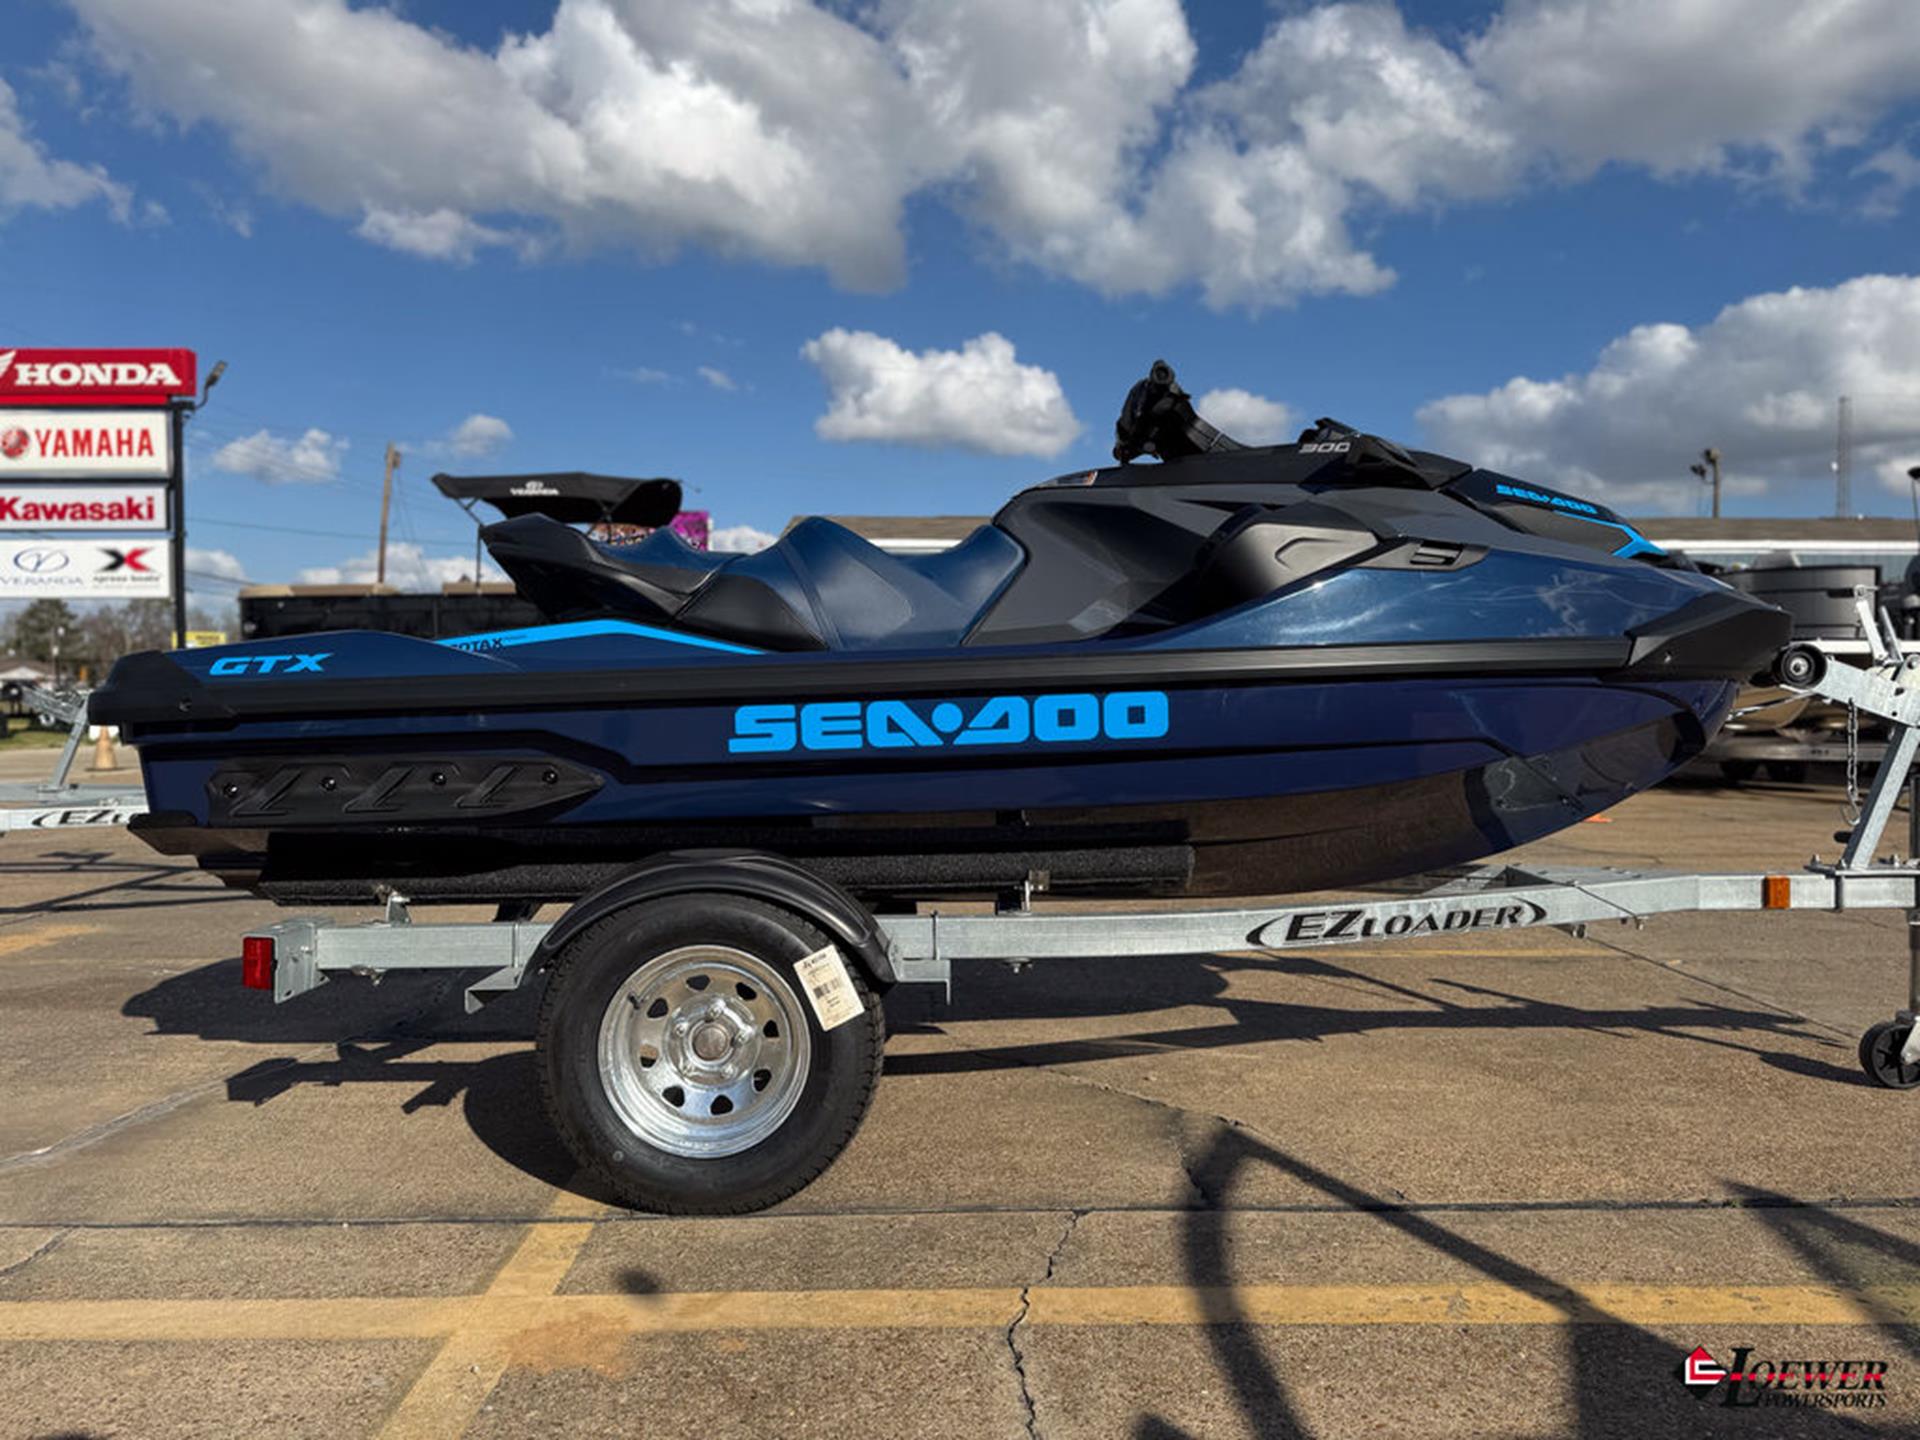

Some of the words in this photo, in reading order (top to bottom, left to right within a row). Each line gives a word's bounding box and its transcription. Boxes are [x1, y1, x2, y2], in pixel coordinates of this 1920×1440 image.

[14, 363, 182, 386] HONDA
[35, 429, 154, 458] YAMAHA
[1299, 441, 1351, 454] 300
[0, 496, 155, 521] Kawasaki
[0, 576, 83, 586] VERANDA
[452, 638, 505, 653] OTAX
[209, 652, 335, 676] GTX
